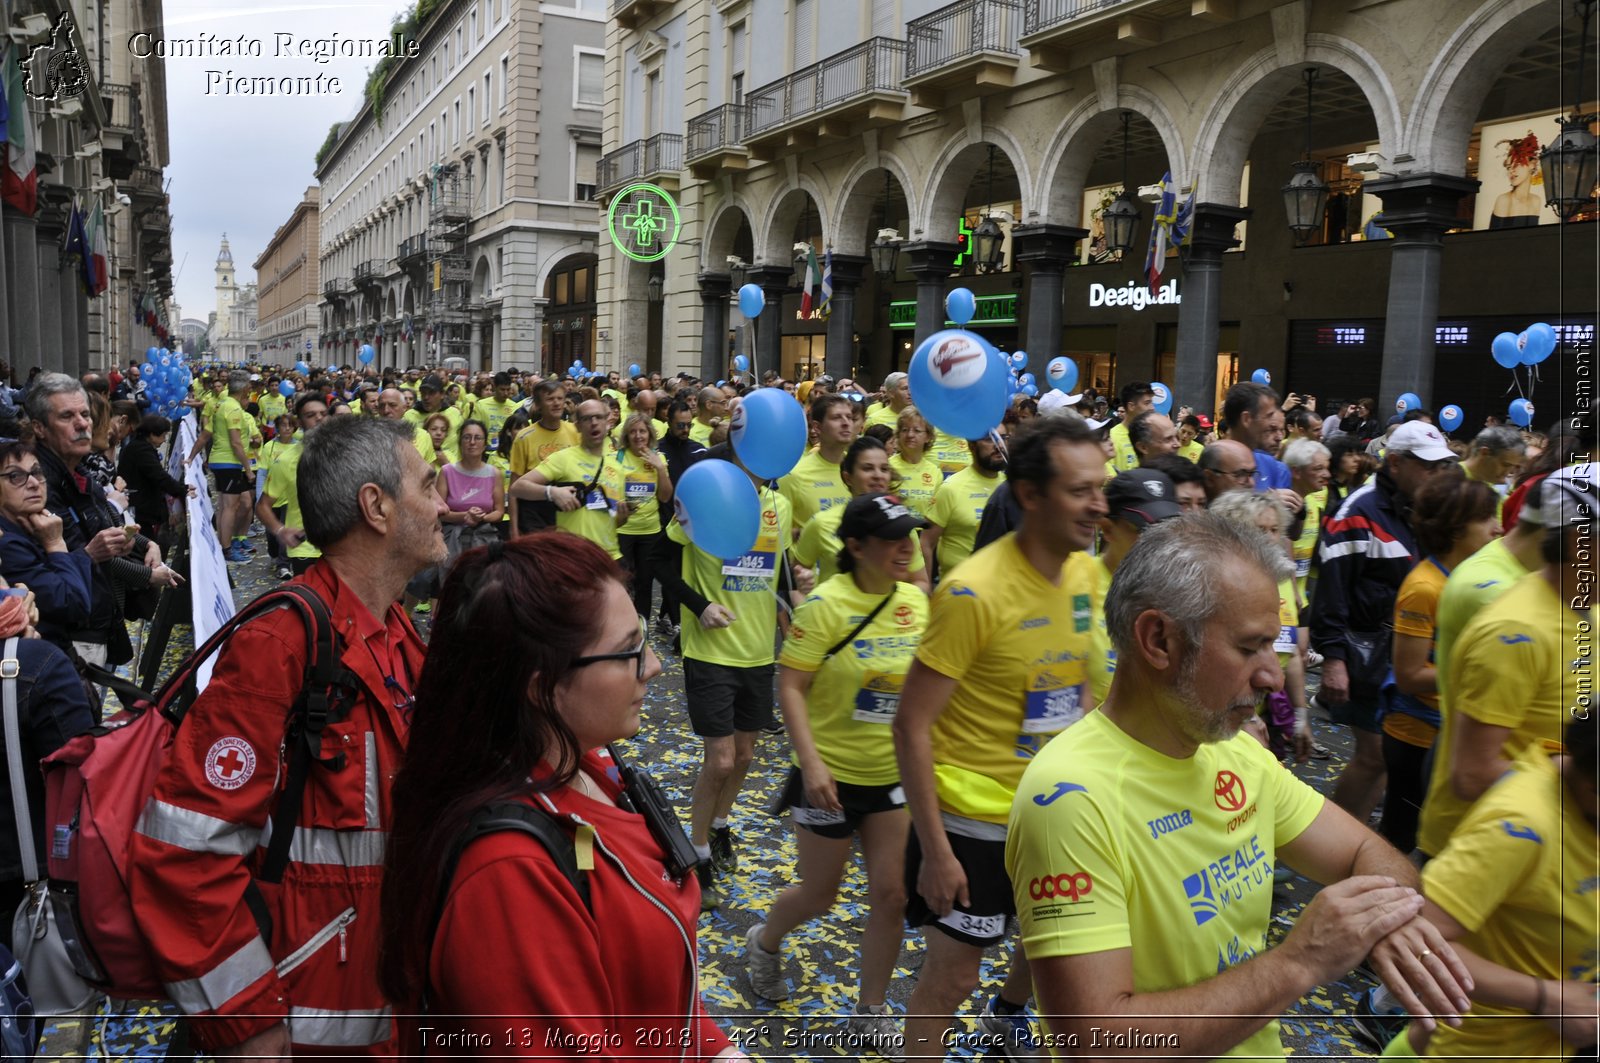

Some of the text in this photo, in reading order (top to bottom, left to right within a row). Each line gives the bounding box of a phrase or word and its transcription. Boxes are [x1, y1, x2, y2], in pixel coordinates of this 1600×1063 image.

[889, 305, 917, 322] FARM
[976, 299, 1017, 319] TRALE
[1334, 328, 1365, 344] TIM
[1226, 803, 1258, 834] TOYOTA
[1209, 834, 1266, 886] REALE
[1029, 872, 1093, 903] coop
[1221, 862, 1274, 908] MUTUA
